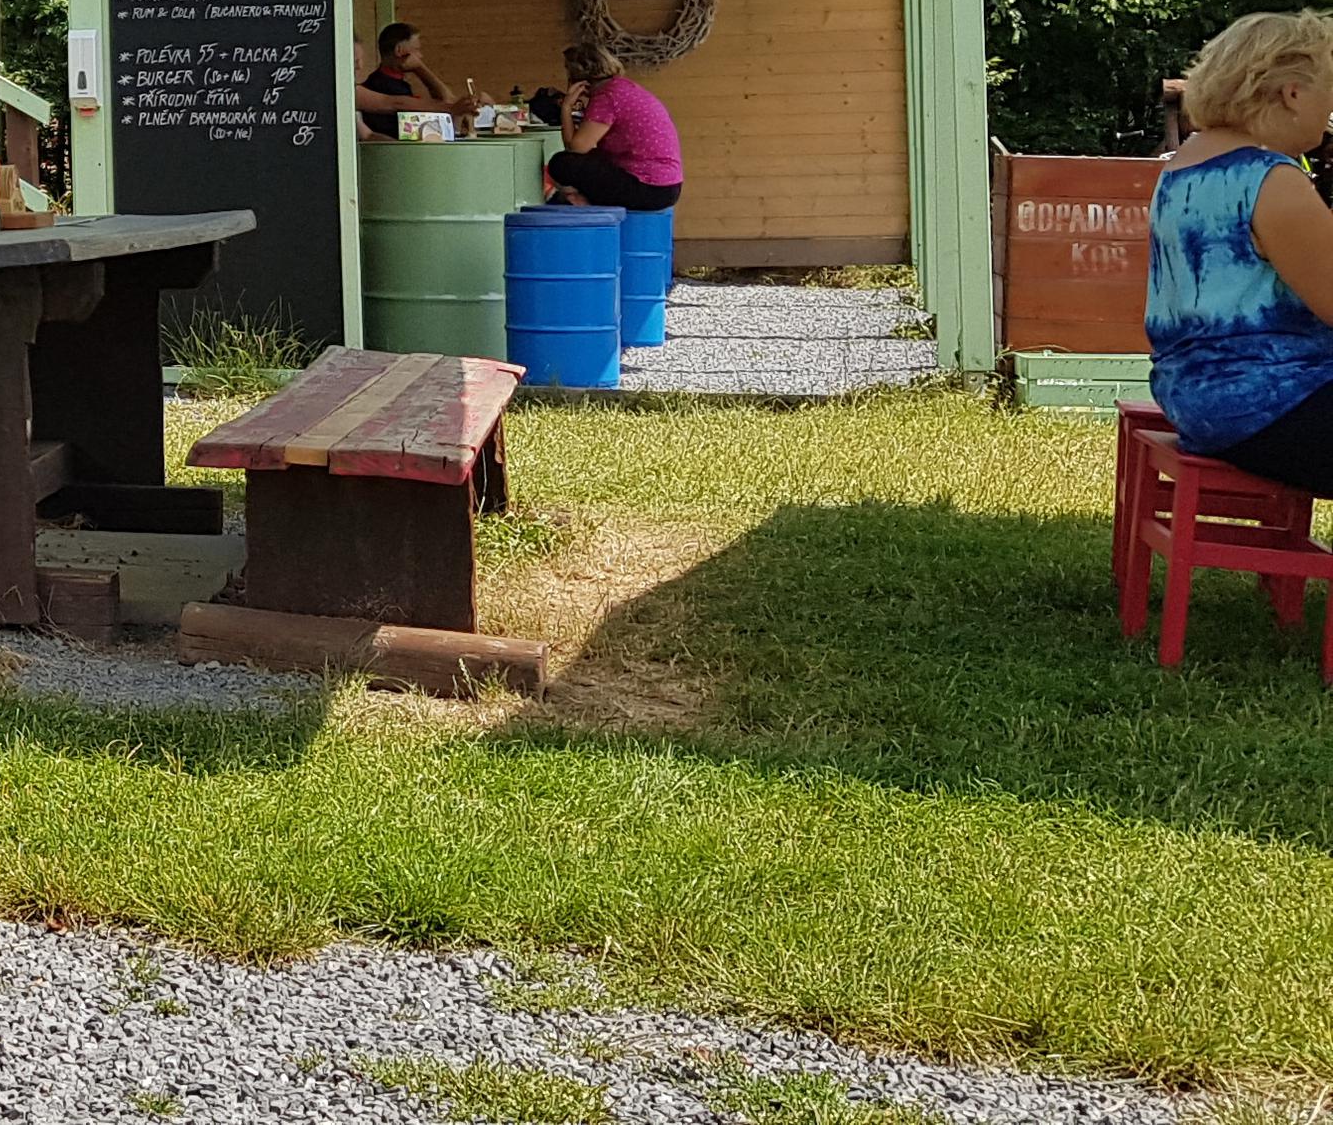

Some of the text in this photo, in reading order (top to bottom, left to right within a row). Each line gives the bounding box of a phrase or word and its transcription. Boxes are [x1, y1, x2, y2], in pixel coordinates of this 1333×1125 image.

[131, 6, 156, 19] RUM
[296, 17, 326, 34] 125
[135, 43, 192, 64] POLÉVKA
[196, 42, 219, 65] 55
[232, 47, 278, 62] PLACKA
[280, 43, 310, 63] 25
[136, 69, 195, 87] BURGER
[138, 88, 205, 107] PŘÍRODNÍ
[261, 86, 286, 105] 45
[189, 106, 256, 125] BRAMBORÁK
[260, 110, 277, 124] NA
[282, 110, 318, 124] GRILU
[292, 125, 322, 145] 85
